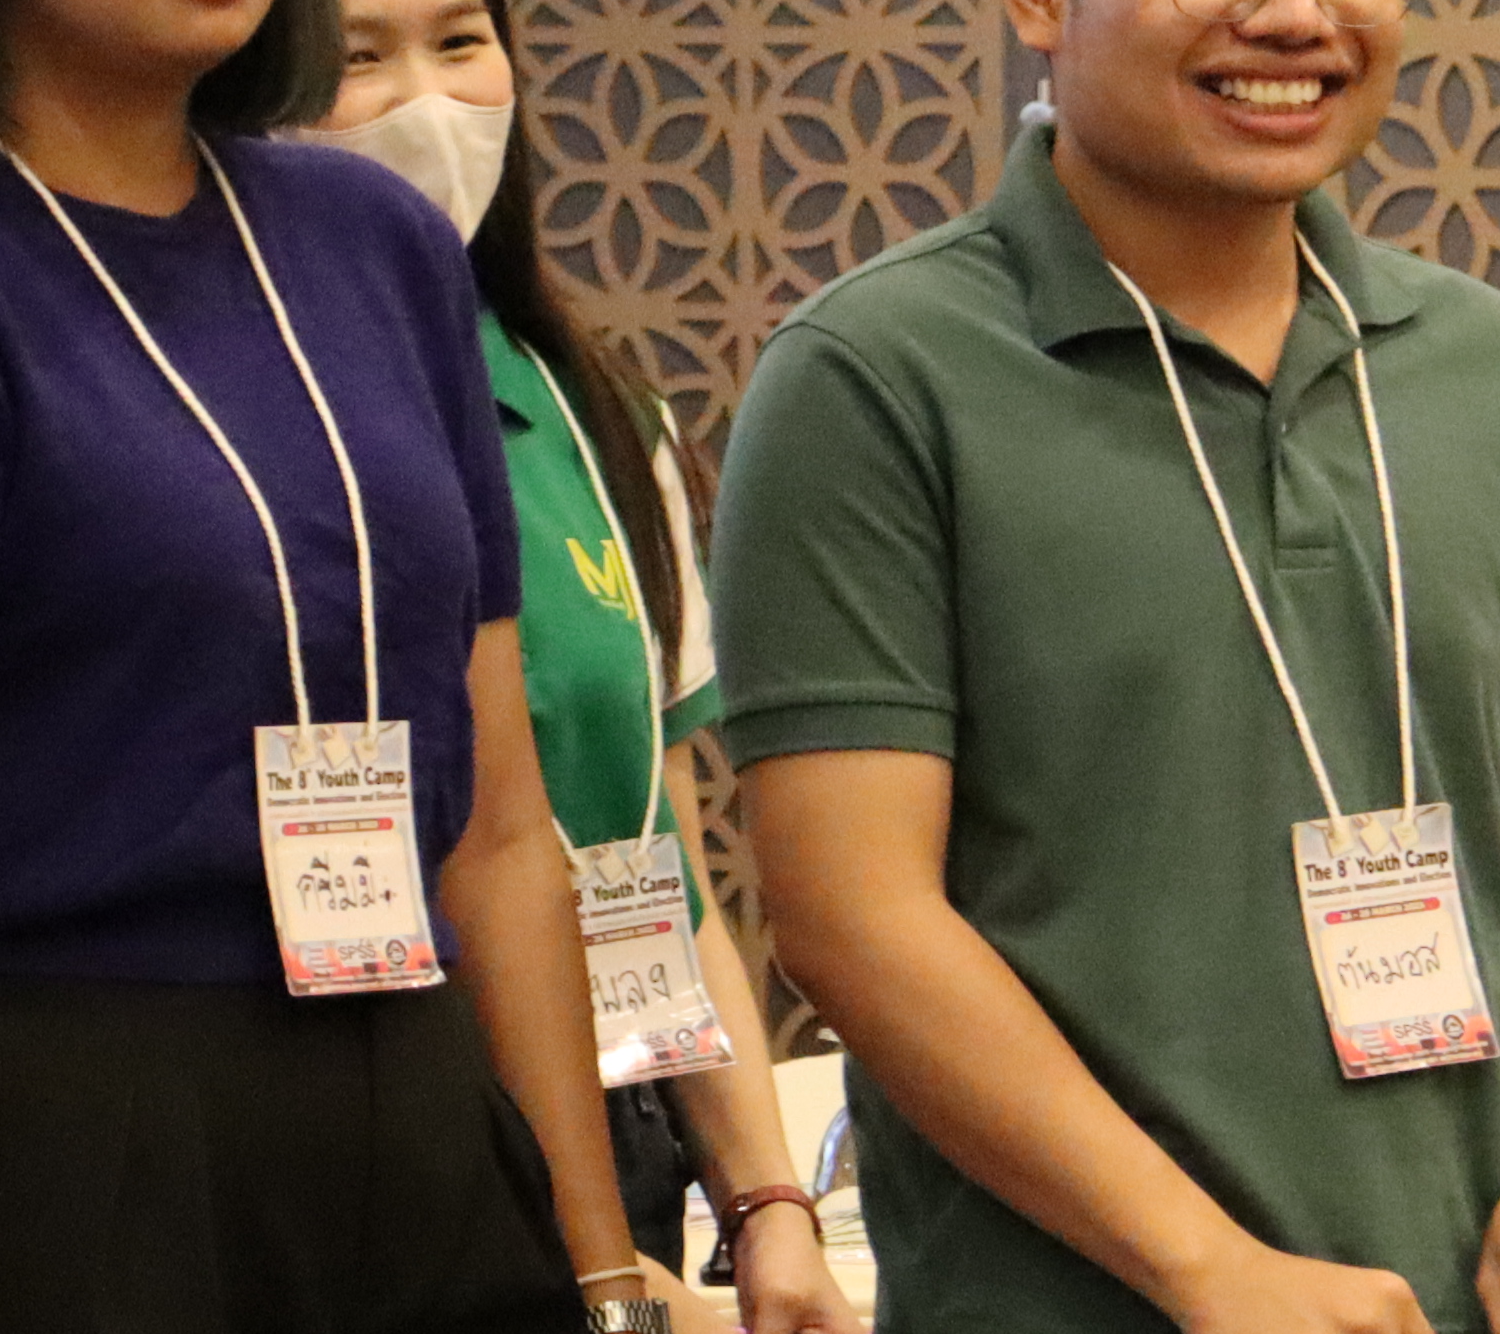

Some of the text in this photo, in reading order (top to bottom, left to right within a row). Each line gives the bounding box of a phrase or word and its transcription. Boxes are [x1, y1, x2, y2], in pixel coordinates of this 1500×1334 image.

[266, 772, 292, 791] The
[317, 768, 360, 787] Youth
[364, 766, 406, 789] Camp
[1304, 863, 1332, 882] The
[1356, 853, 1400, 875] Youth
[1406, 849, 1449, 870] Camp
[640, 876, 680, 894] Camp
